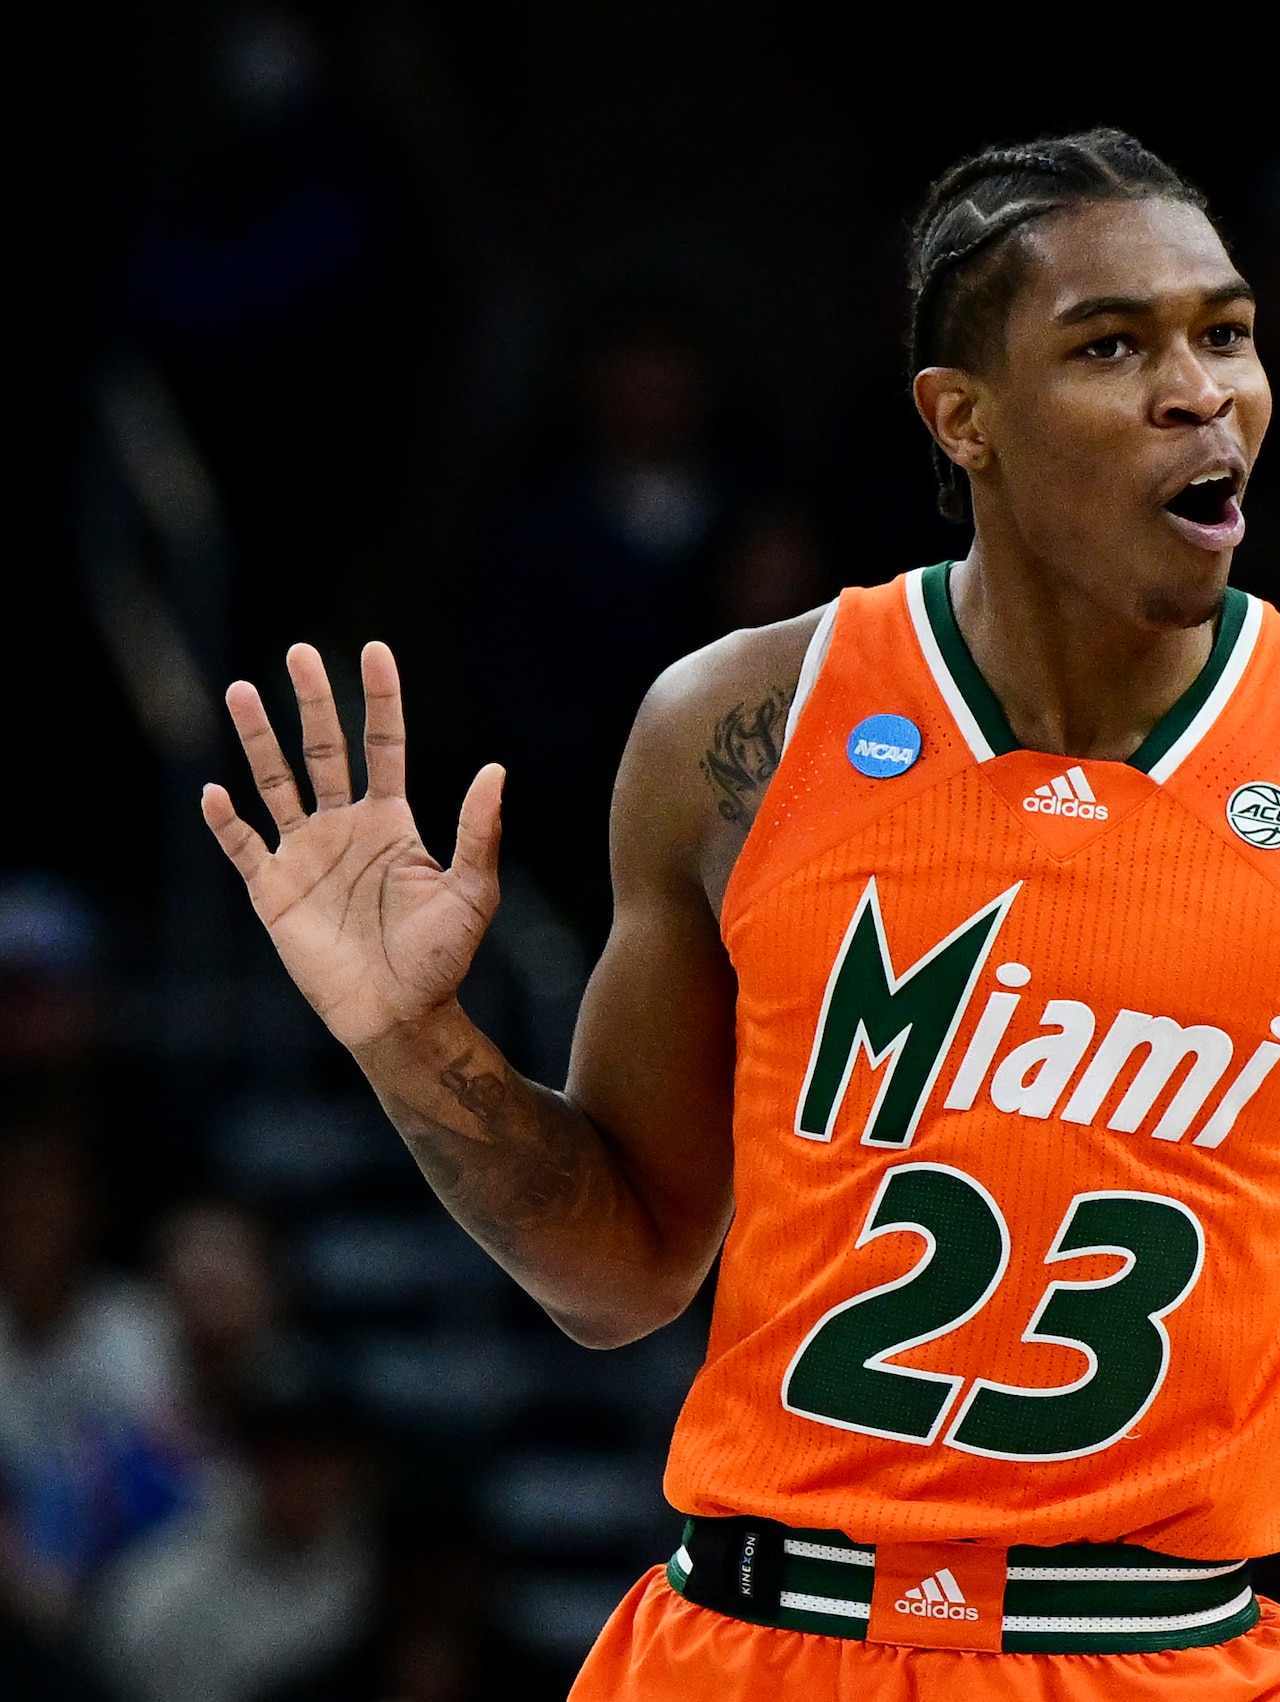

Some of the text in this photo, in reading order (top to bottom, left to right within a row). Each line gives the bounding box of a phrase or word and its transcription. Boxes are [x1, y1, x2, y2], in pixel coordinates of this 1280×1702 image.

[854, 739, 914, 765] NCAA
[1022, 795, 1109, 820] adidas
[781, 1161, 1205, 1462] 23
[741, 1535, 756, 1595] KINEXON
[894, 1599, 979, 1621] adidas
